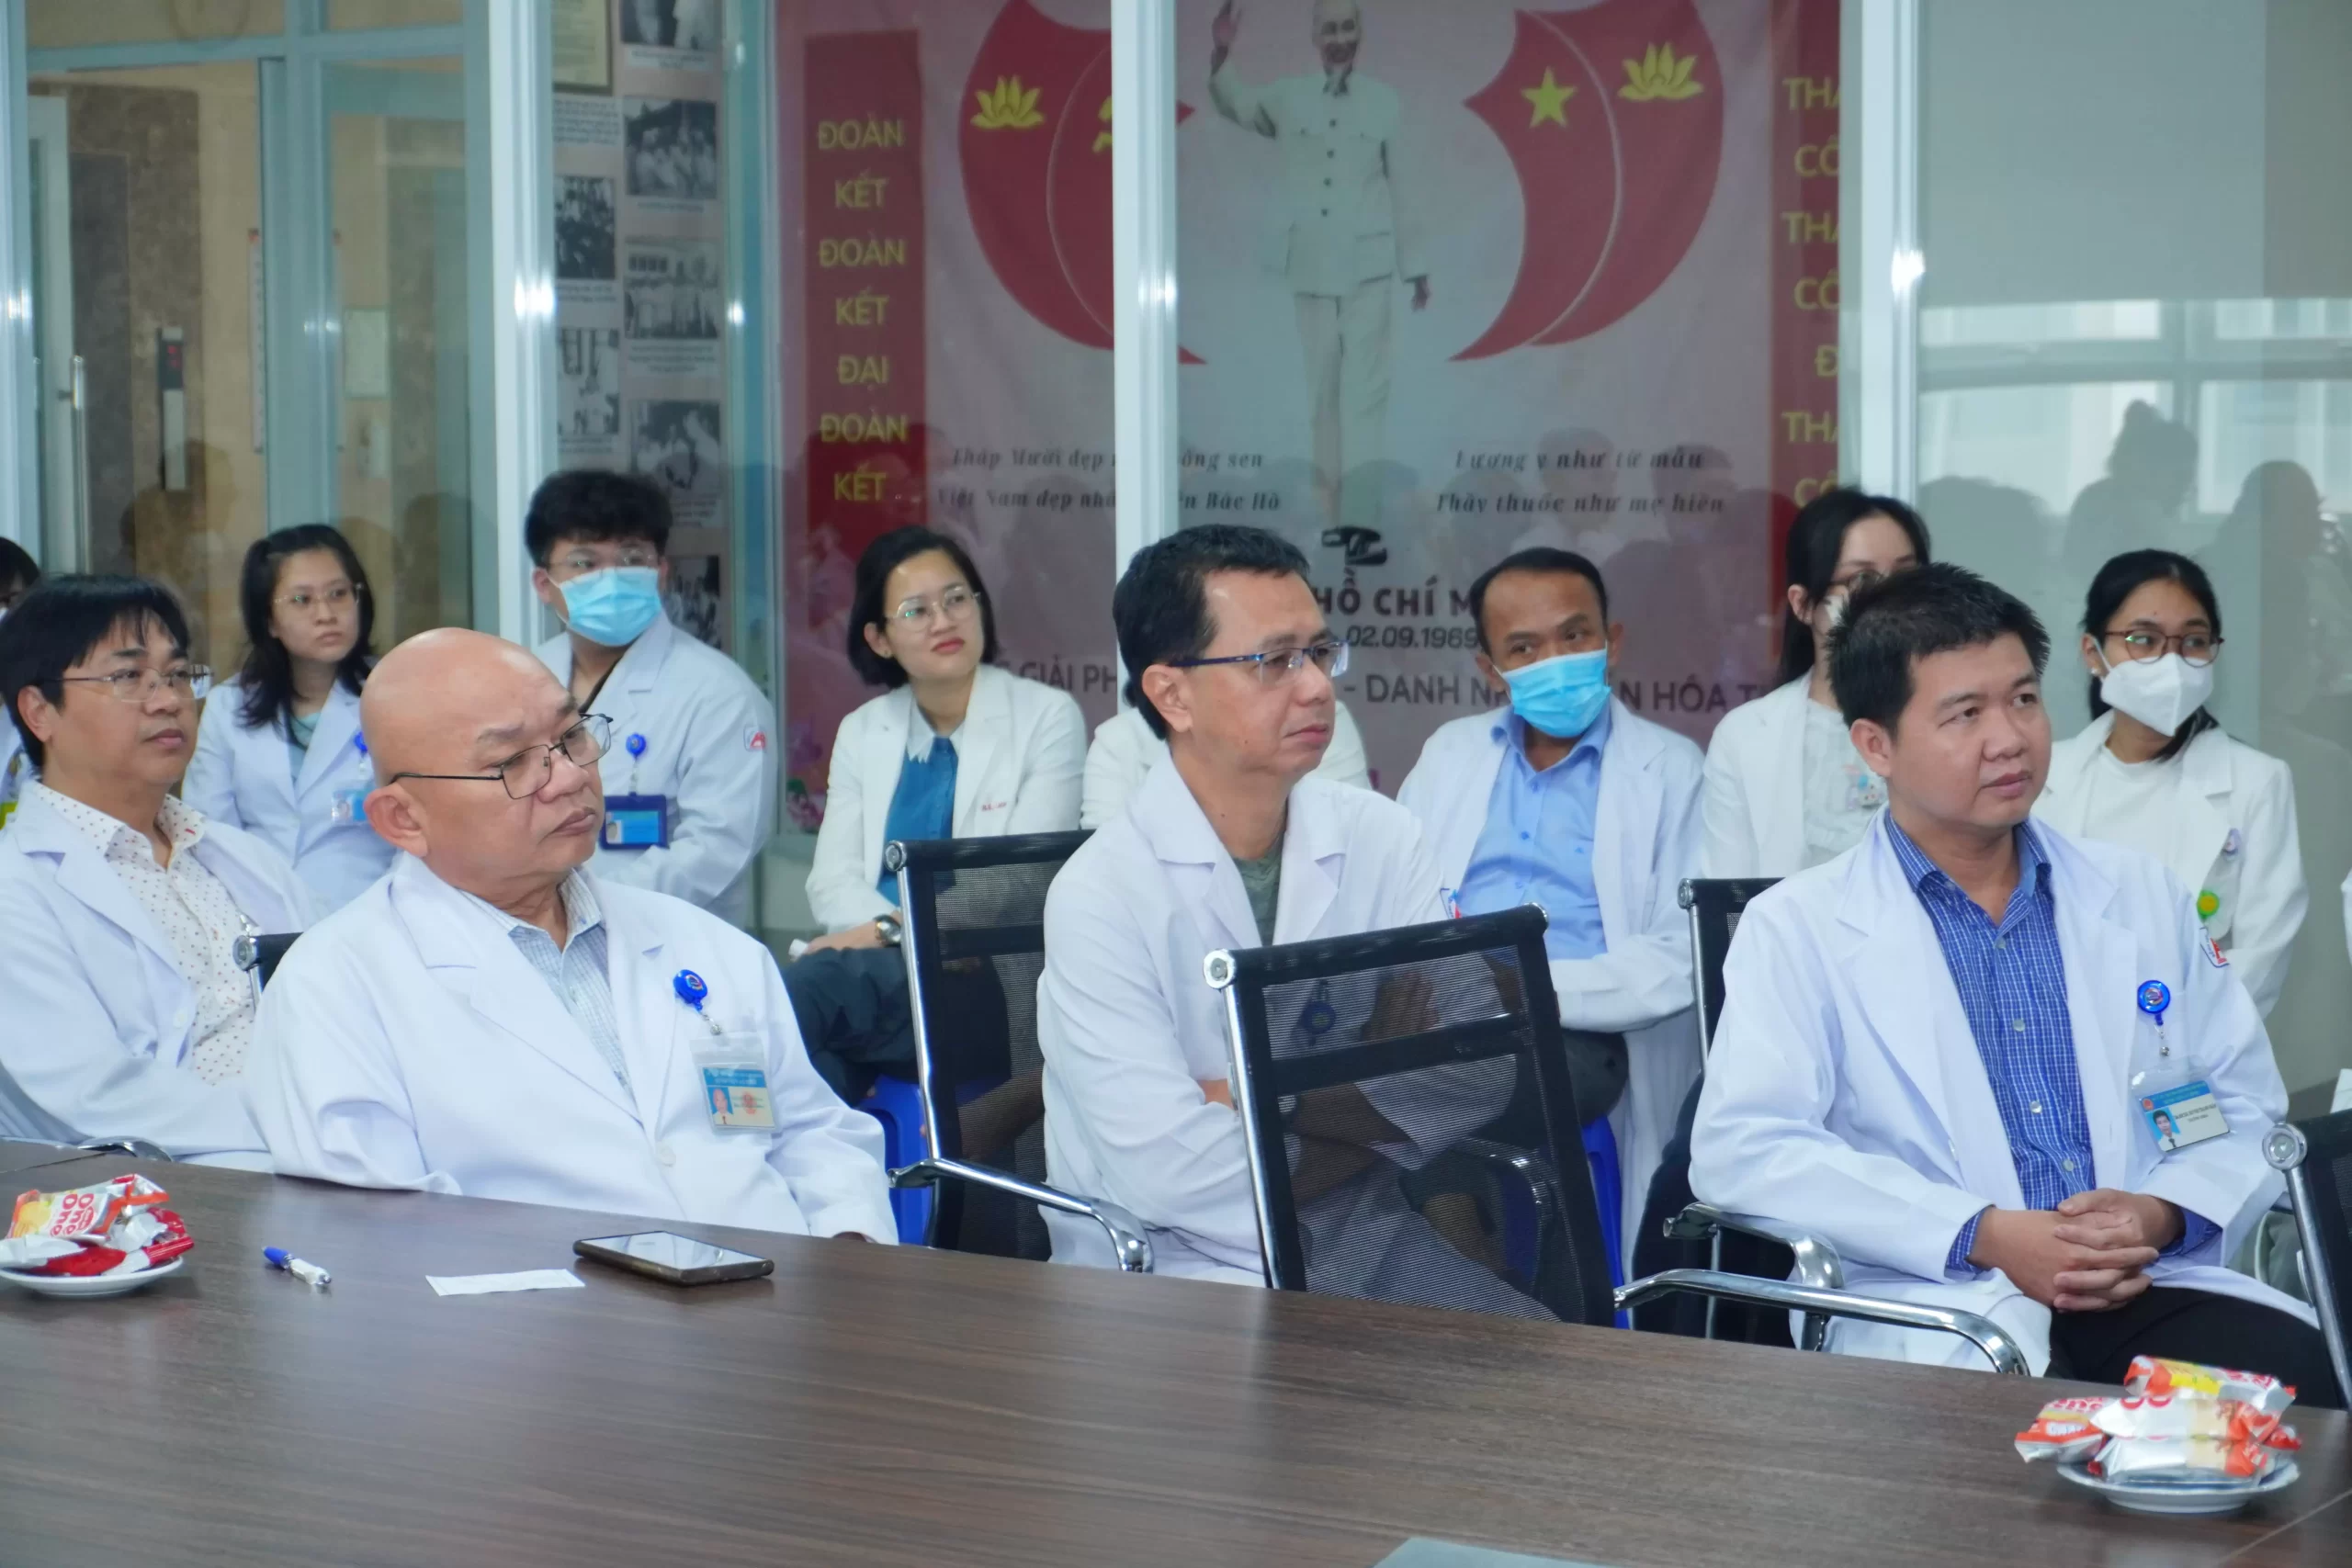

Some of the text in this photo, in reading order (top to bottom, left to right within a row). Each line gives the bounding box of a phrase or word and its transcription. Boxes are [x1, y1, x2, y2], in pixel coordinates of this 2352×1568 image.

[817, 111, 905, 150] ĐOÀN
[835, 168, 889, 209] KẾT
[1781, 210, 1838, 243] TH
[817, 228, 907, 267] ĐOÀN
[835, 285, 889, 326] KẾT
[836, 355, 889, 392] ĐẠI
[819, 406, 908, 444] ĐOÀN
[1781, 411, 1838, 443] TH
[1182, 449, 1263, 472] ông sen
[1556, 449, 1606, 469] như
[833, 461, 887, 502] KẾT
[1574, 492, 1620, 513] như
[1373, 575, 1438, 617] CHÍ
[1083, 663, 1118, 694] PH
[1365, 673, 1460, 705] DANH
[1653, 672, 1727, 714] HÓA
